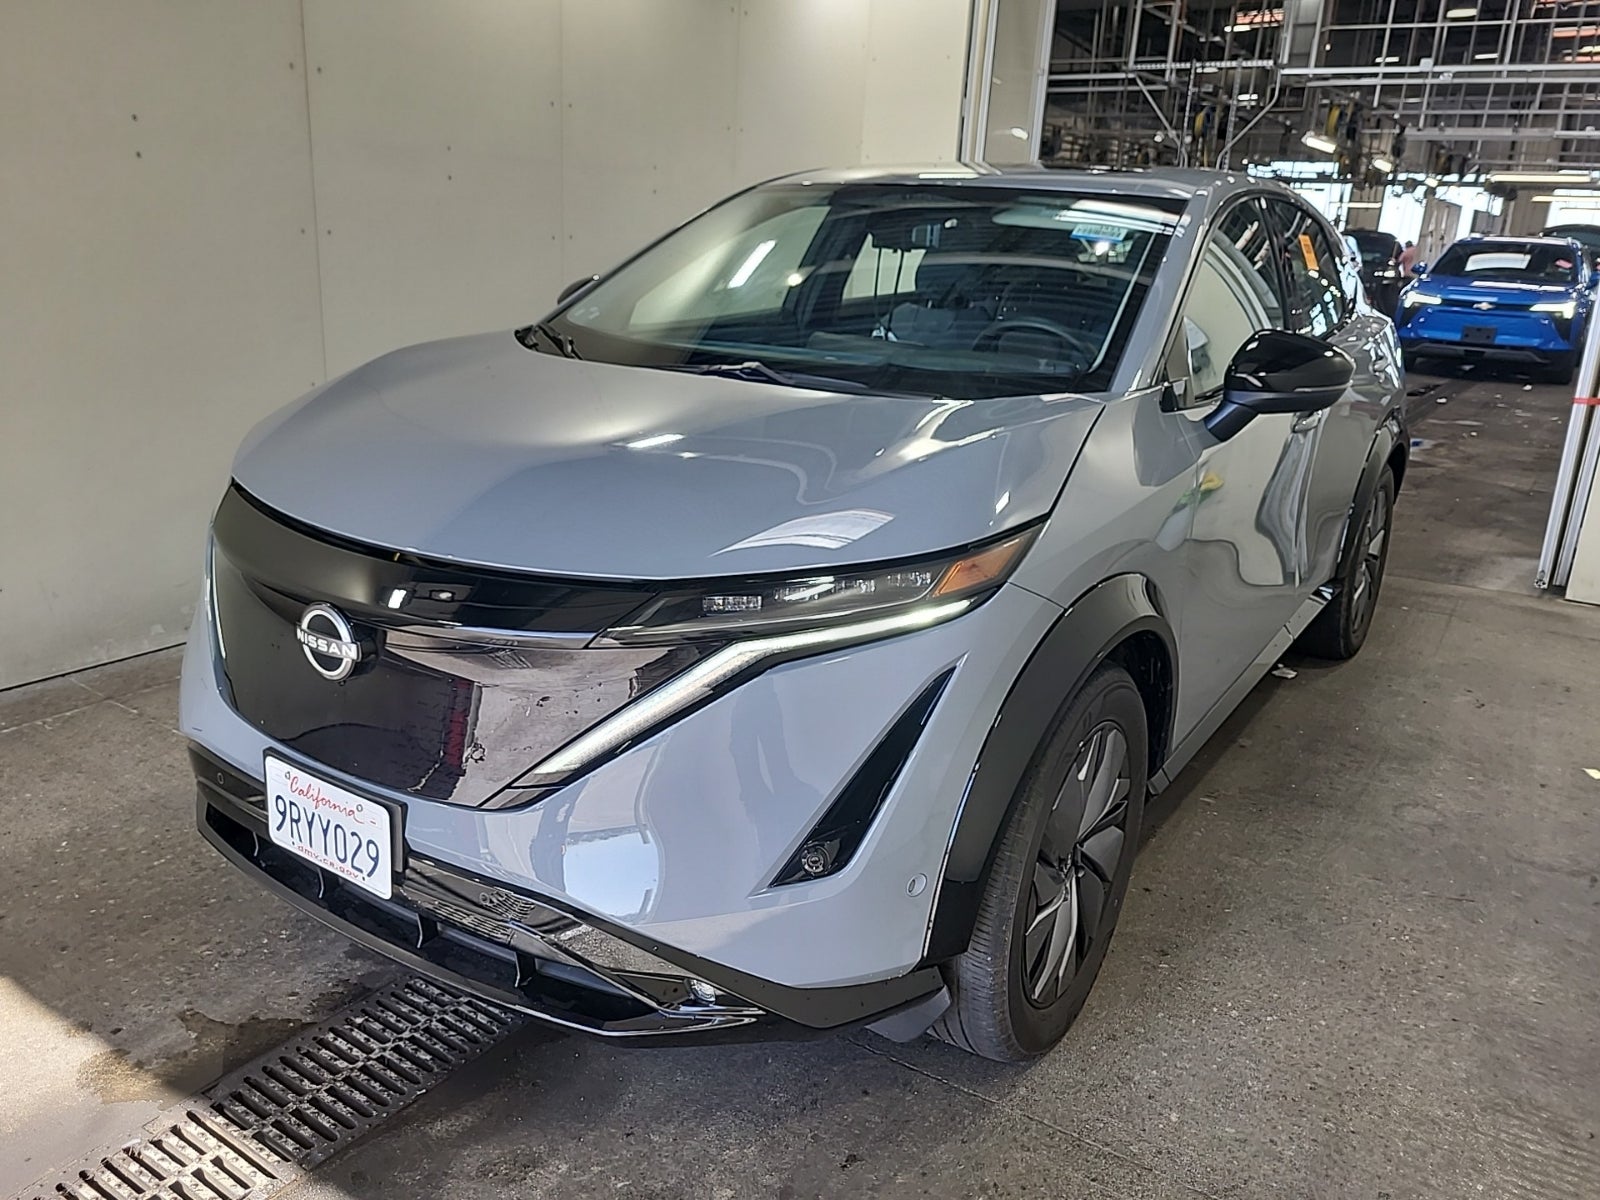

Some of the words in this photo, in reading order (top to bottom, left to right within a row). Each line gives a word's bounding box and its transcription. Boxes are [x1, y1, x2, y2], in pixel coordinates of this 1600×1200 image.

[296, 626, 358, 660] NISSAN
[290, 776, 364, 824] California
[275, 794, 380, 878] 9RYY029
